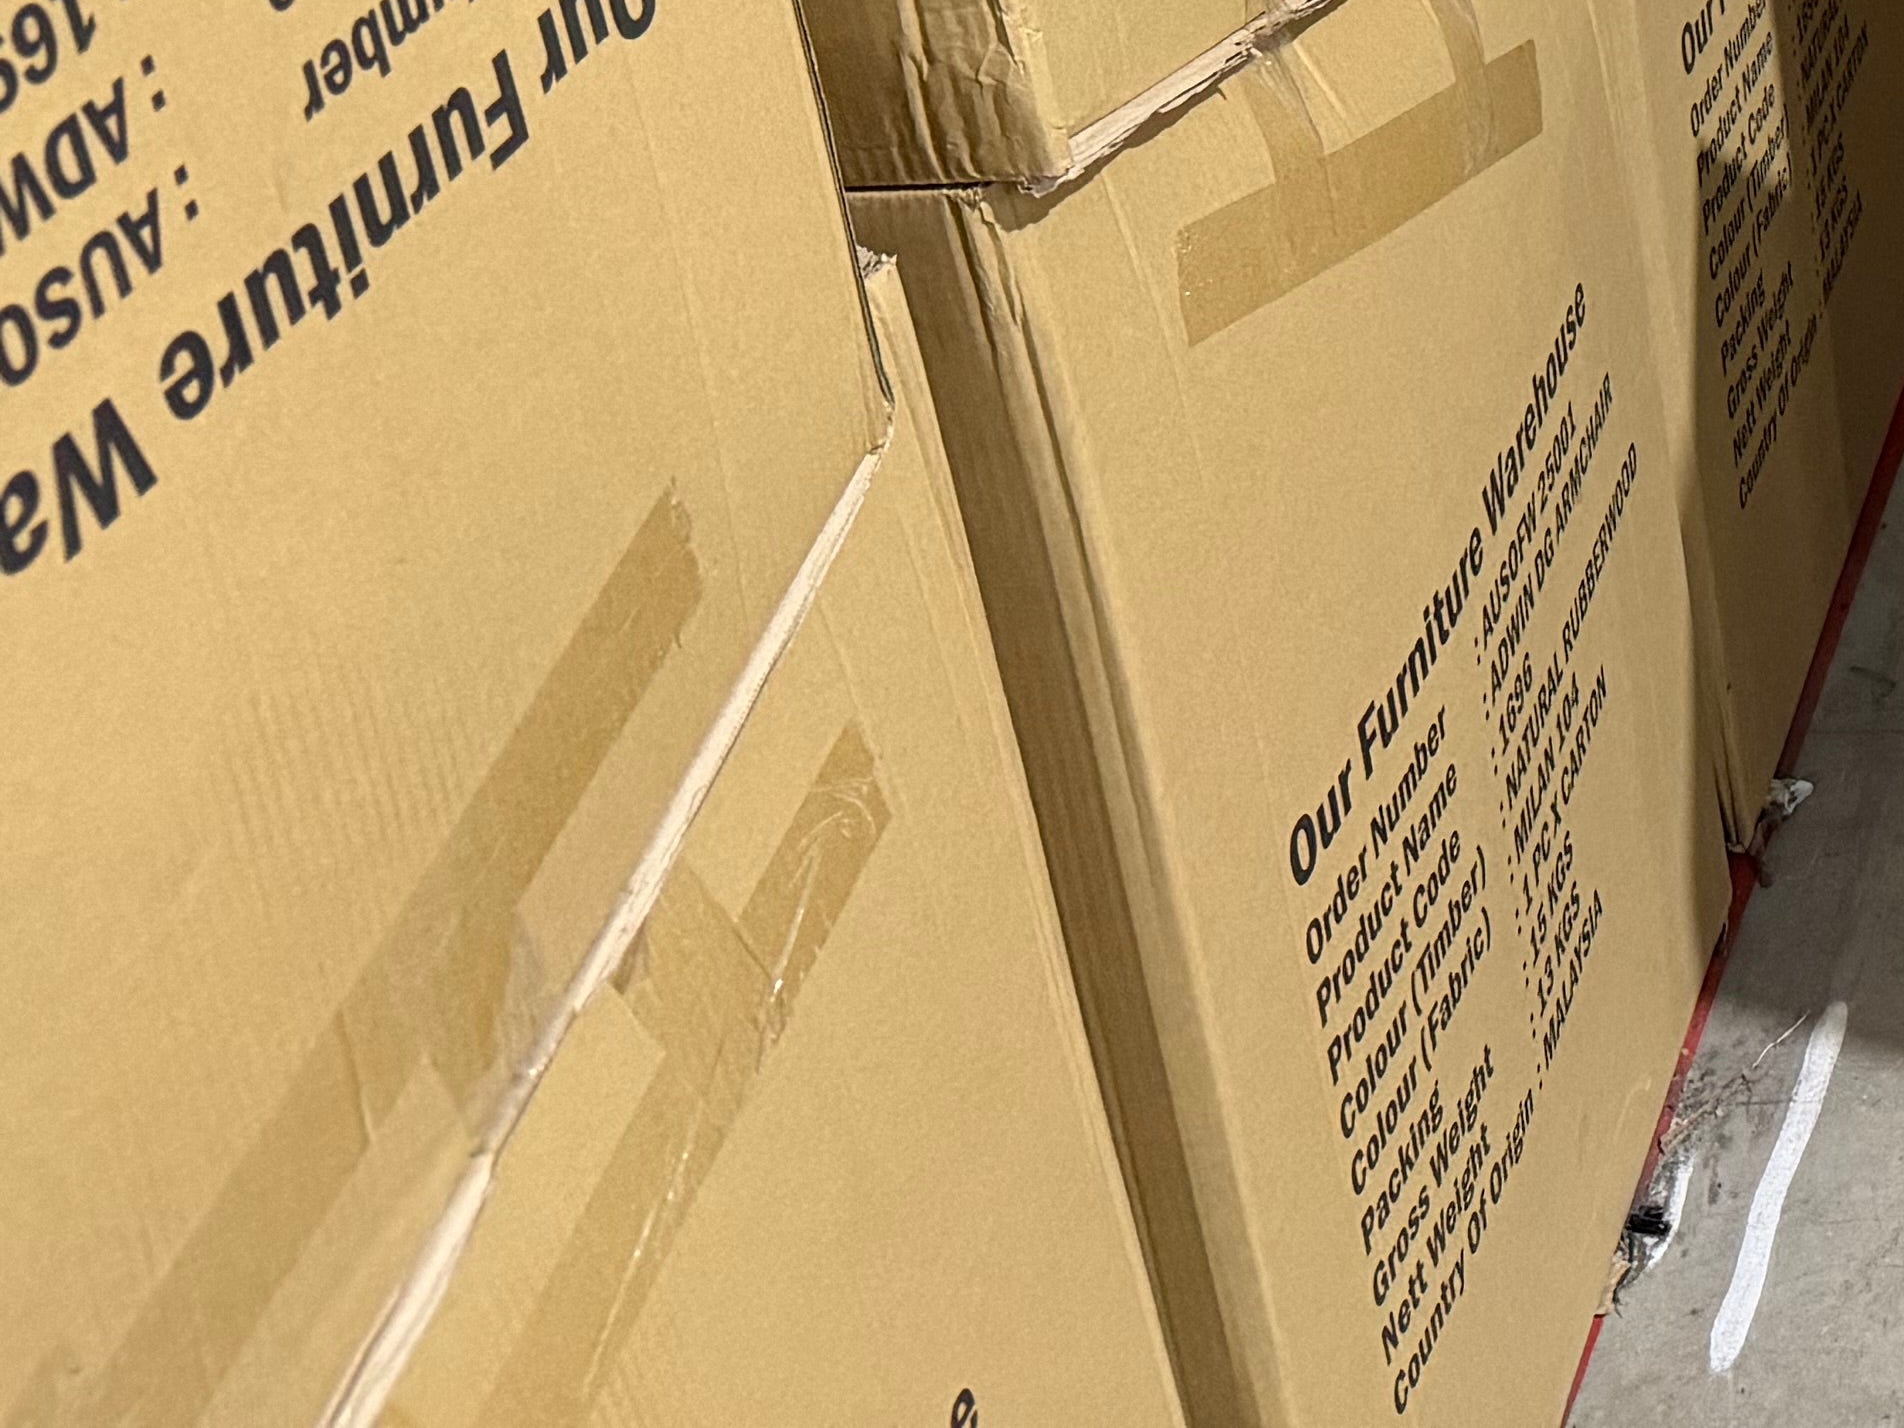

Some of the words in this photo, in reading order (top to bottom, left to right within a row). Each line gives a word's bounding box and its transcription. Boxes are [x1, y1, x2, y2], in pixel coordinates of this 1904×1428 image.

[157, 47, 529, 421] Furniture
[1288, 756, 1353, 887] Our
[1355, 525, 1484, 781] Furniture
[1480, 281, 1586, 537] Warehouse
[1304, 842, 1368, 965] Order
[1368, 703, 1446, 861] Number
[1481, 489, 1537, 652] AUSOFW
[1536, 399, 1577, 516] 25001
[1392, 1246, 1465, 1415] Country
[1466, 1186, 1488, 1255] Of
[1488, 1086, 1535, 1205] Origin
[1541, 887, 1603, 1071] MALAYSIA
